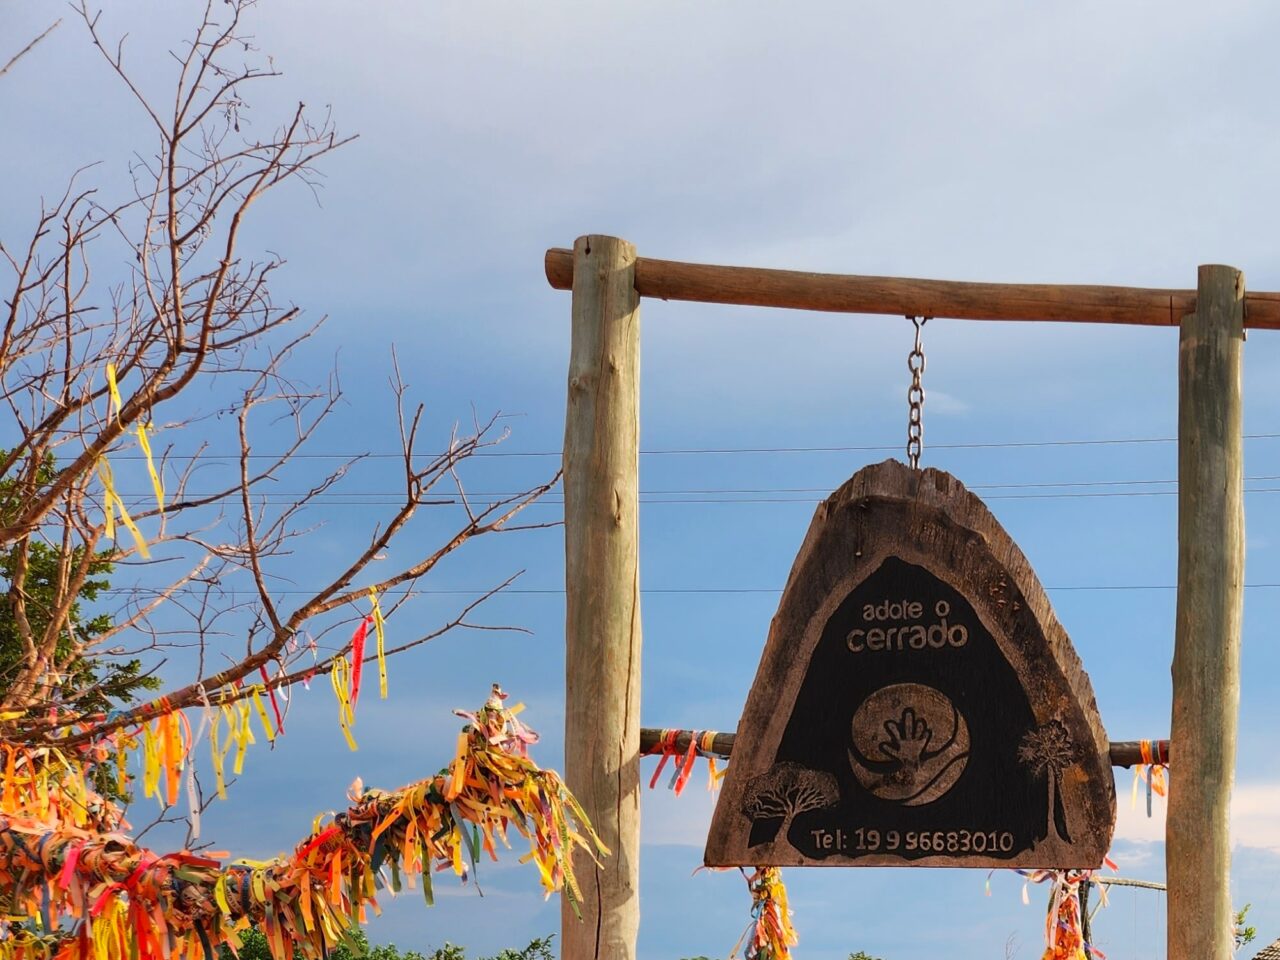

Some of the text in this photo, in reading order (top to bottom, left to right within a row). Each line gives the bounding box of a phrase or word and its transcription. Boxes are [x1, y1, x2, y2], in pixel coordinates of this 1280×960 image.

[863, 600, 950, 621] adote o
[846, 619, 968, 652] cerrado
[810, 828, 847, 850] Tel:
